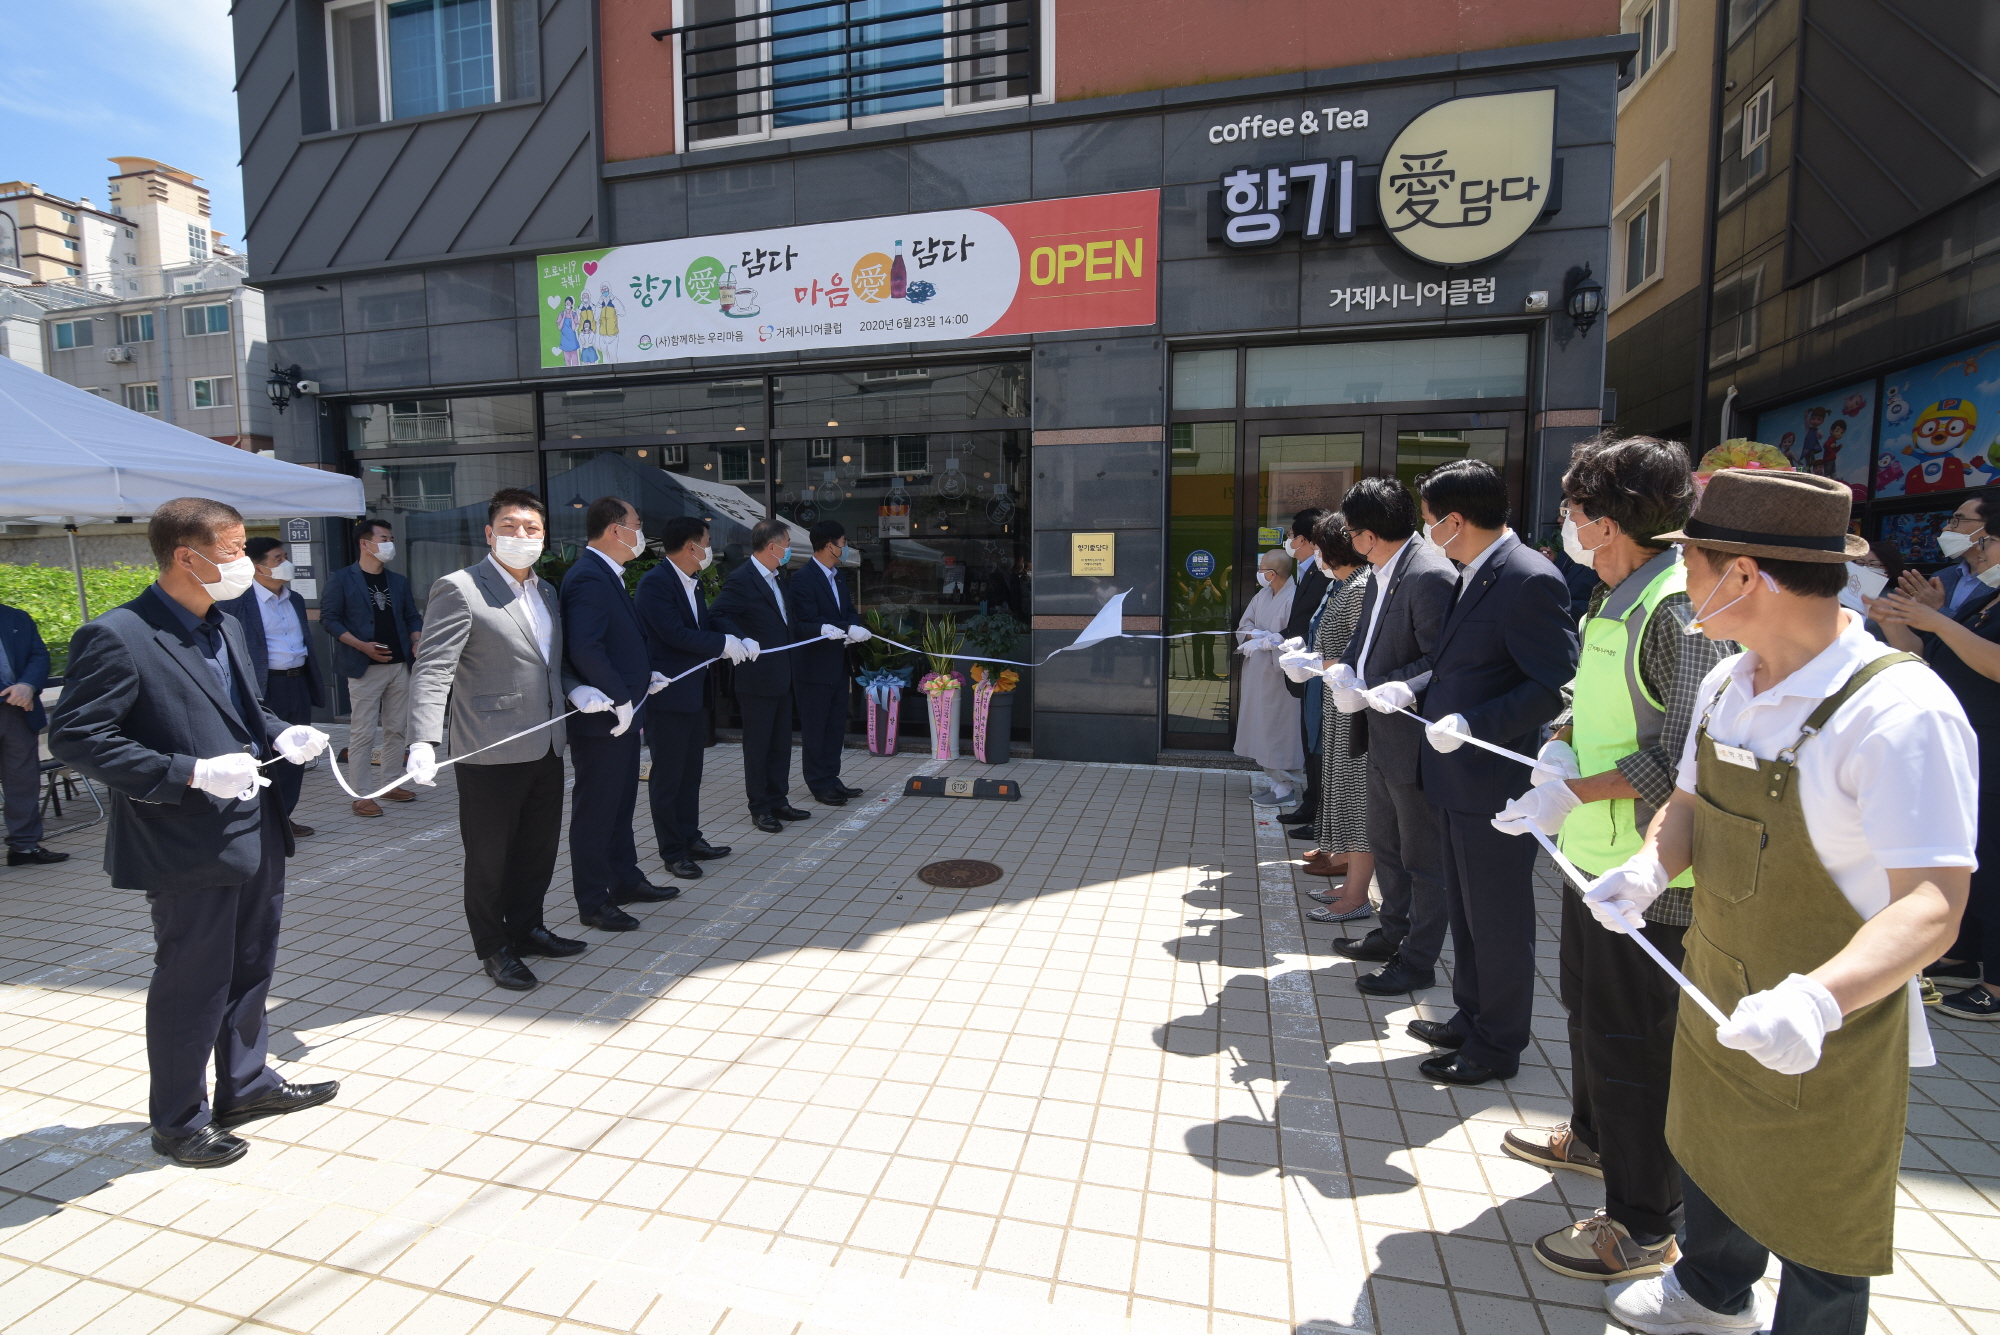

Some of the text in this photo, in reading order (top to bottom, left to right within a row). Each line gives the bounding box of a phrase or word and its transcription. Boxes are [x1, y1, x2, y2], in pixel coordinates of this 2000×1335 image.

[1209, 107, 1369, 144] coffee & Tea
[1222, 158, 1356, 244] 향기
[742, 245, 799, 279] 담다
[912, 233, 975, 269] 담다
[1030, 238, 1143, 286] OPEN
[1330, 277, 1496, 312] 거제시니어클럽
[655, 331, 744, 349] (사)함께하는 우리마음
[776, 322, 842, 339] 거제시니어클럽
[859, 313, 969, 332] 2020년 6월 23일 14:00
[291, 530, 308, 540] 91-1
